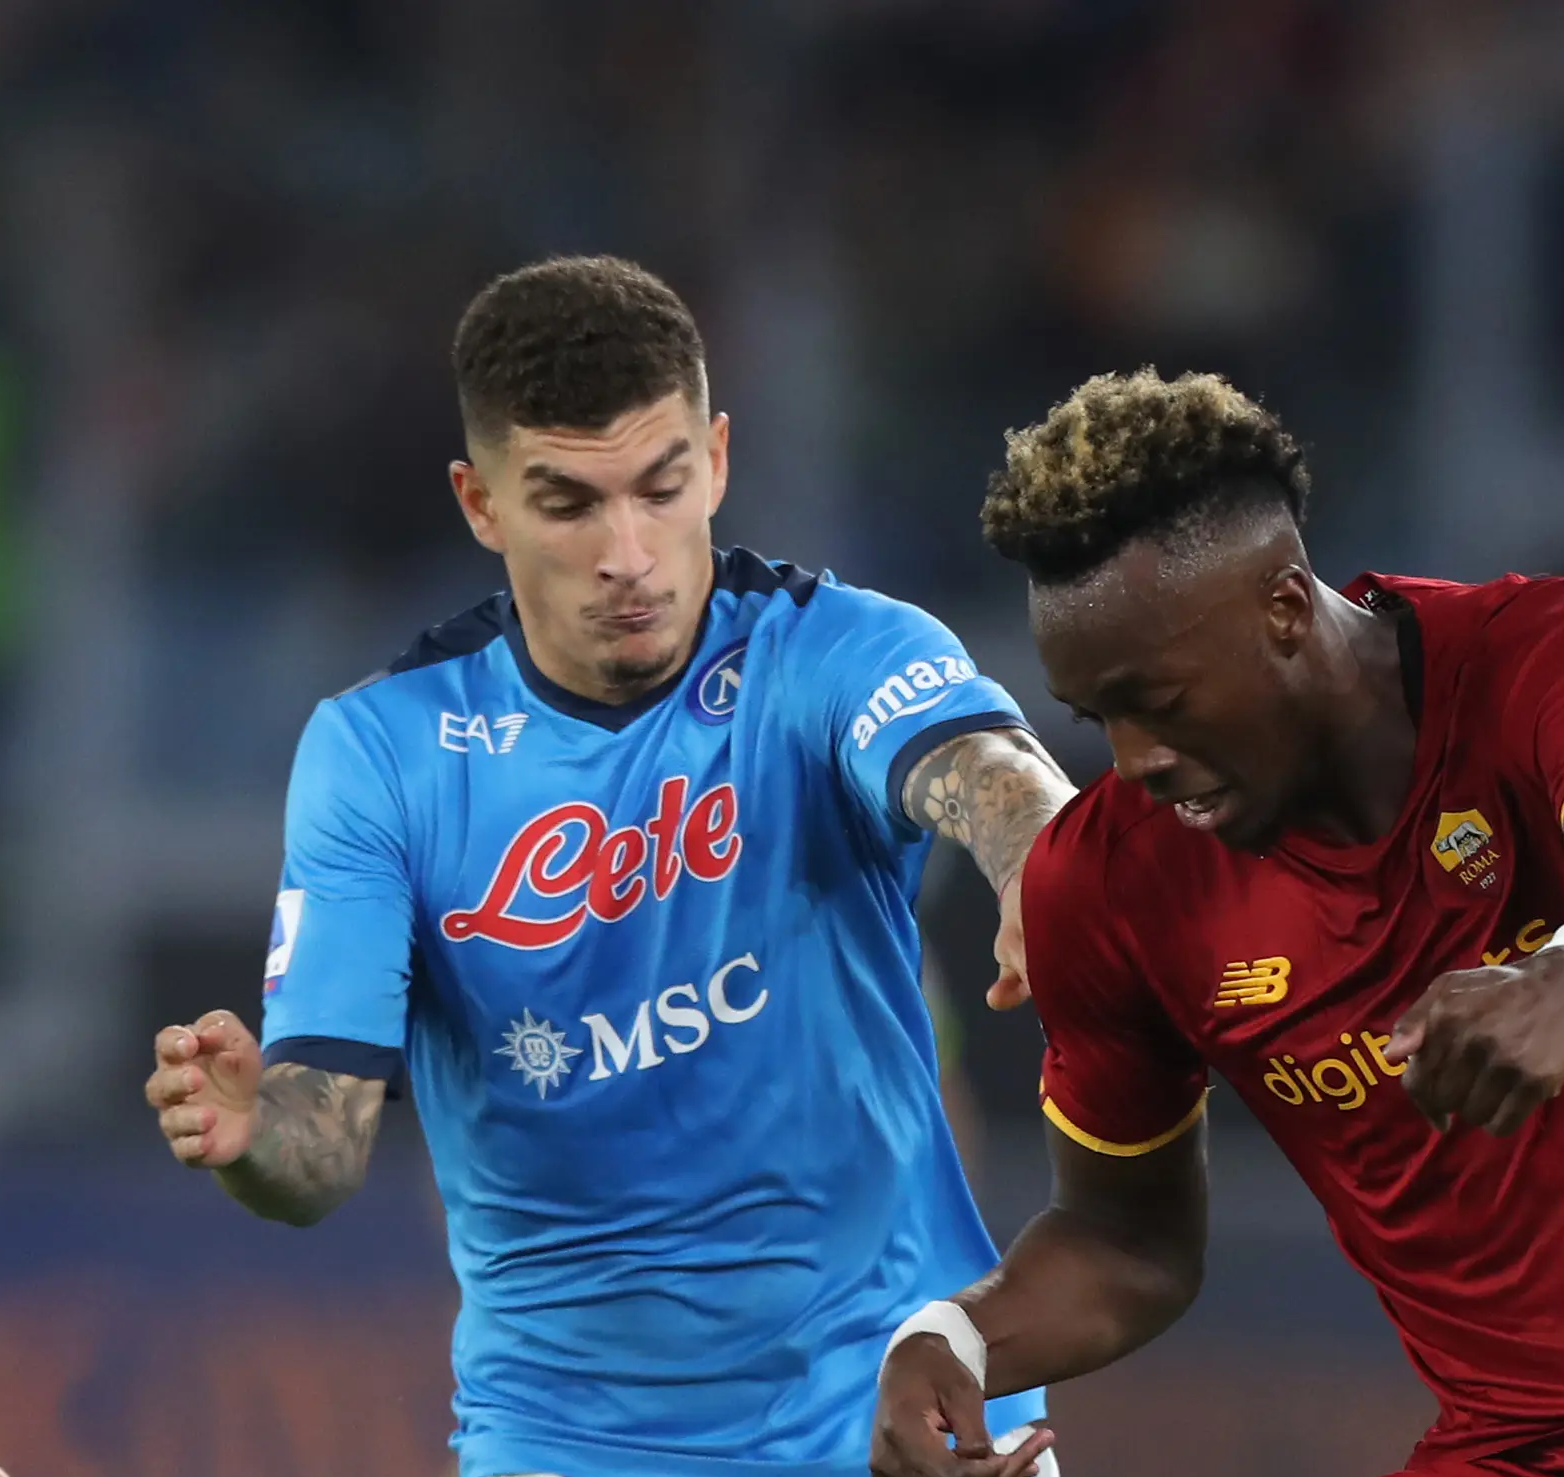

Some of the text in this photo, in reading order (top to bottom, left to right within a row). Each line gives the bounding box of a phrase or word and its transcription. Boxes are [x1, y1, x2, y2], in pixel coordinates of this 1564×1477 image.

[439, 711, 530, 755] EA7
[440, 774, 743, 951] Lete
[1458, 849, 1502, 886] ROMA
[1479, 871, 1498, 890] 1927
[580, 952, 768, 1081] MSC
